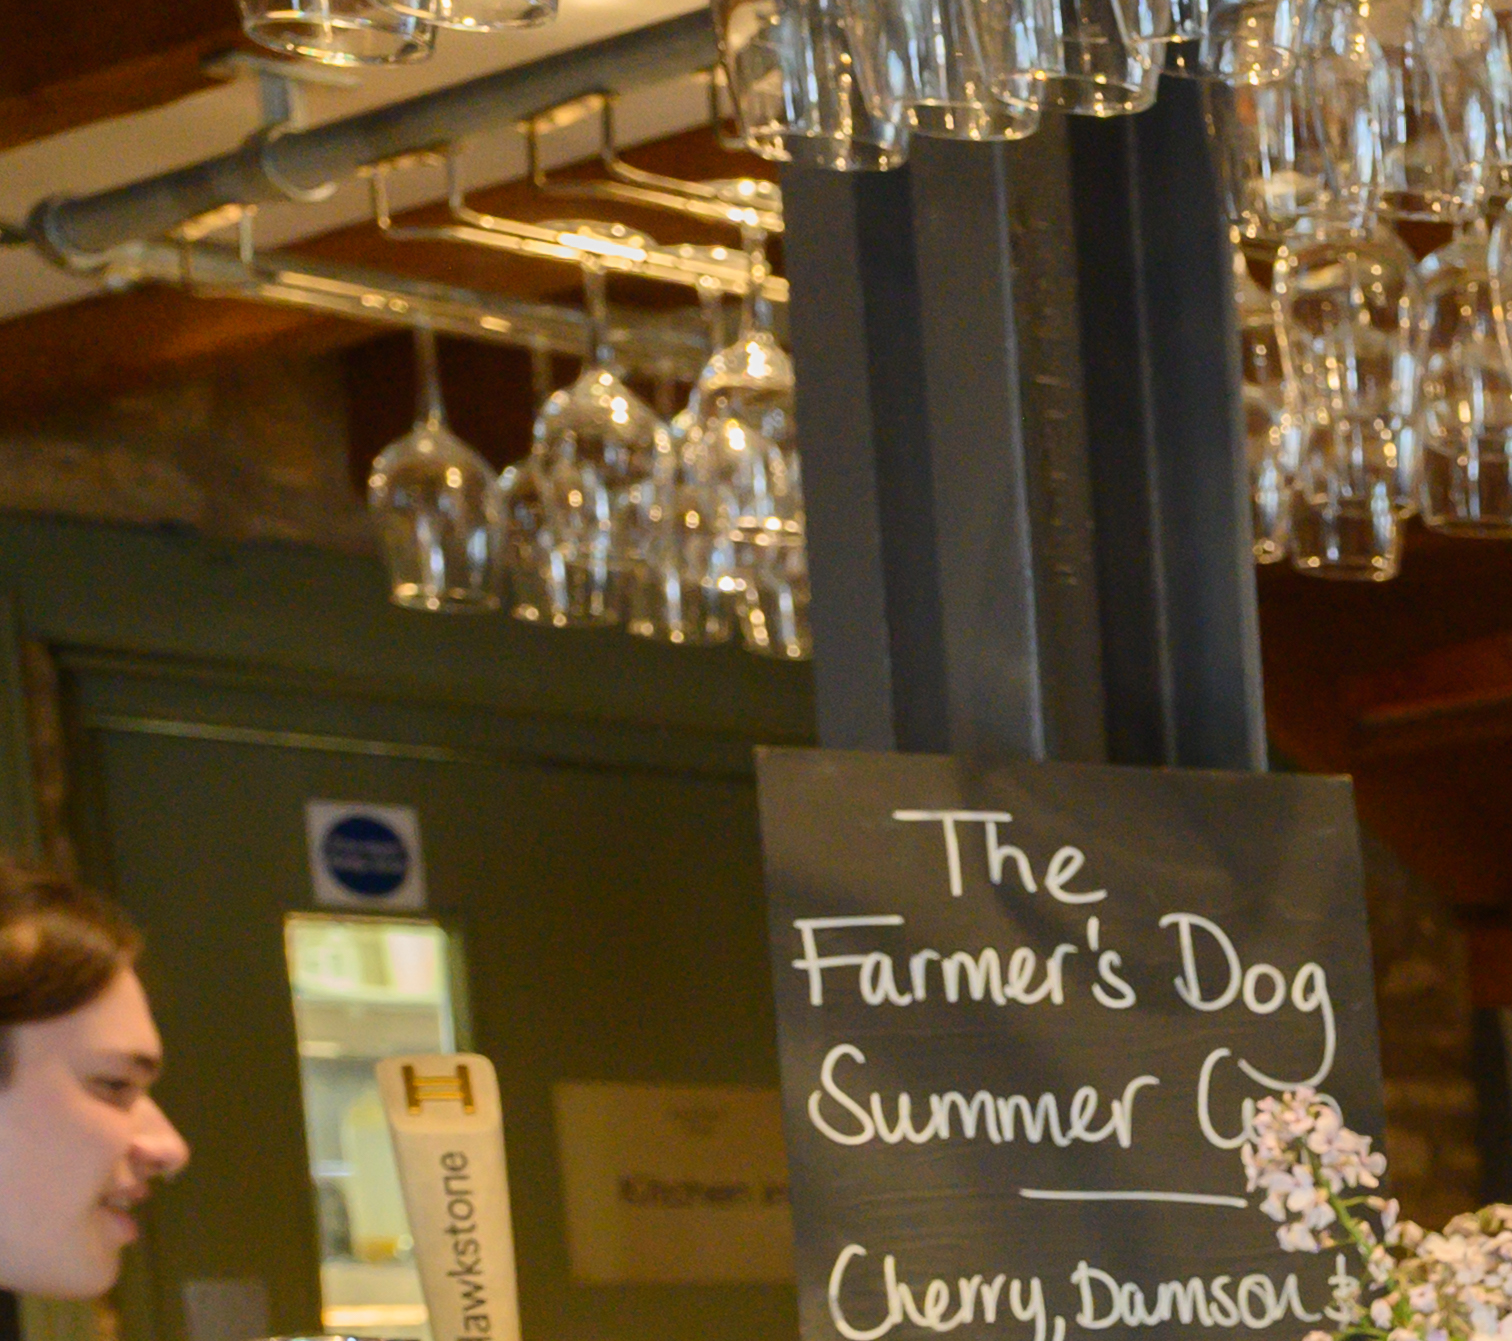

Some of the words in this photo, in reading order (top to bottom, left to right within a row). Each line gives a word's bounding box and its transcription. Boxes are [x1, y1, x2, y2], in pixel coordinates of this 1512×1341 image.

[892, 809, 1106, 904] The
[792, 914, 1136, 1009] Farmer's
[1159, 911, 1337, 1091] Dog
[807, 1044, 1159, 1148] Summer
